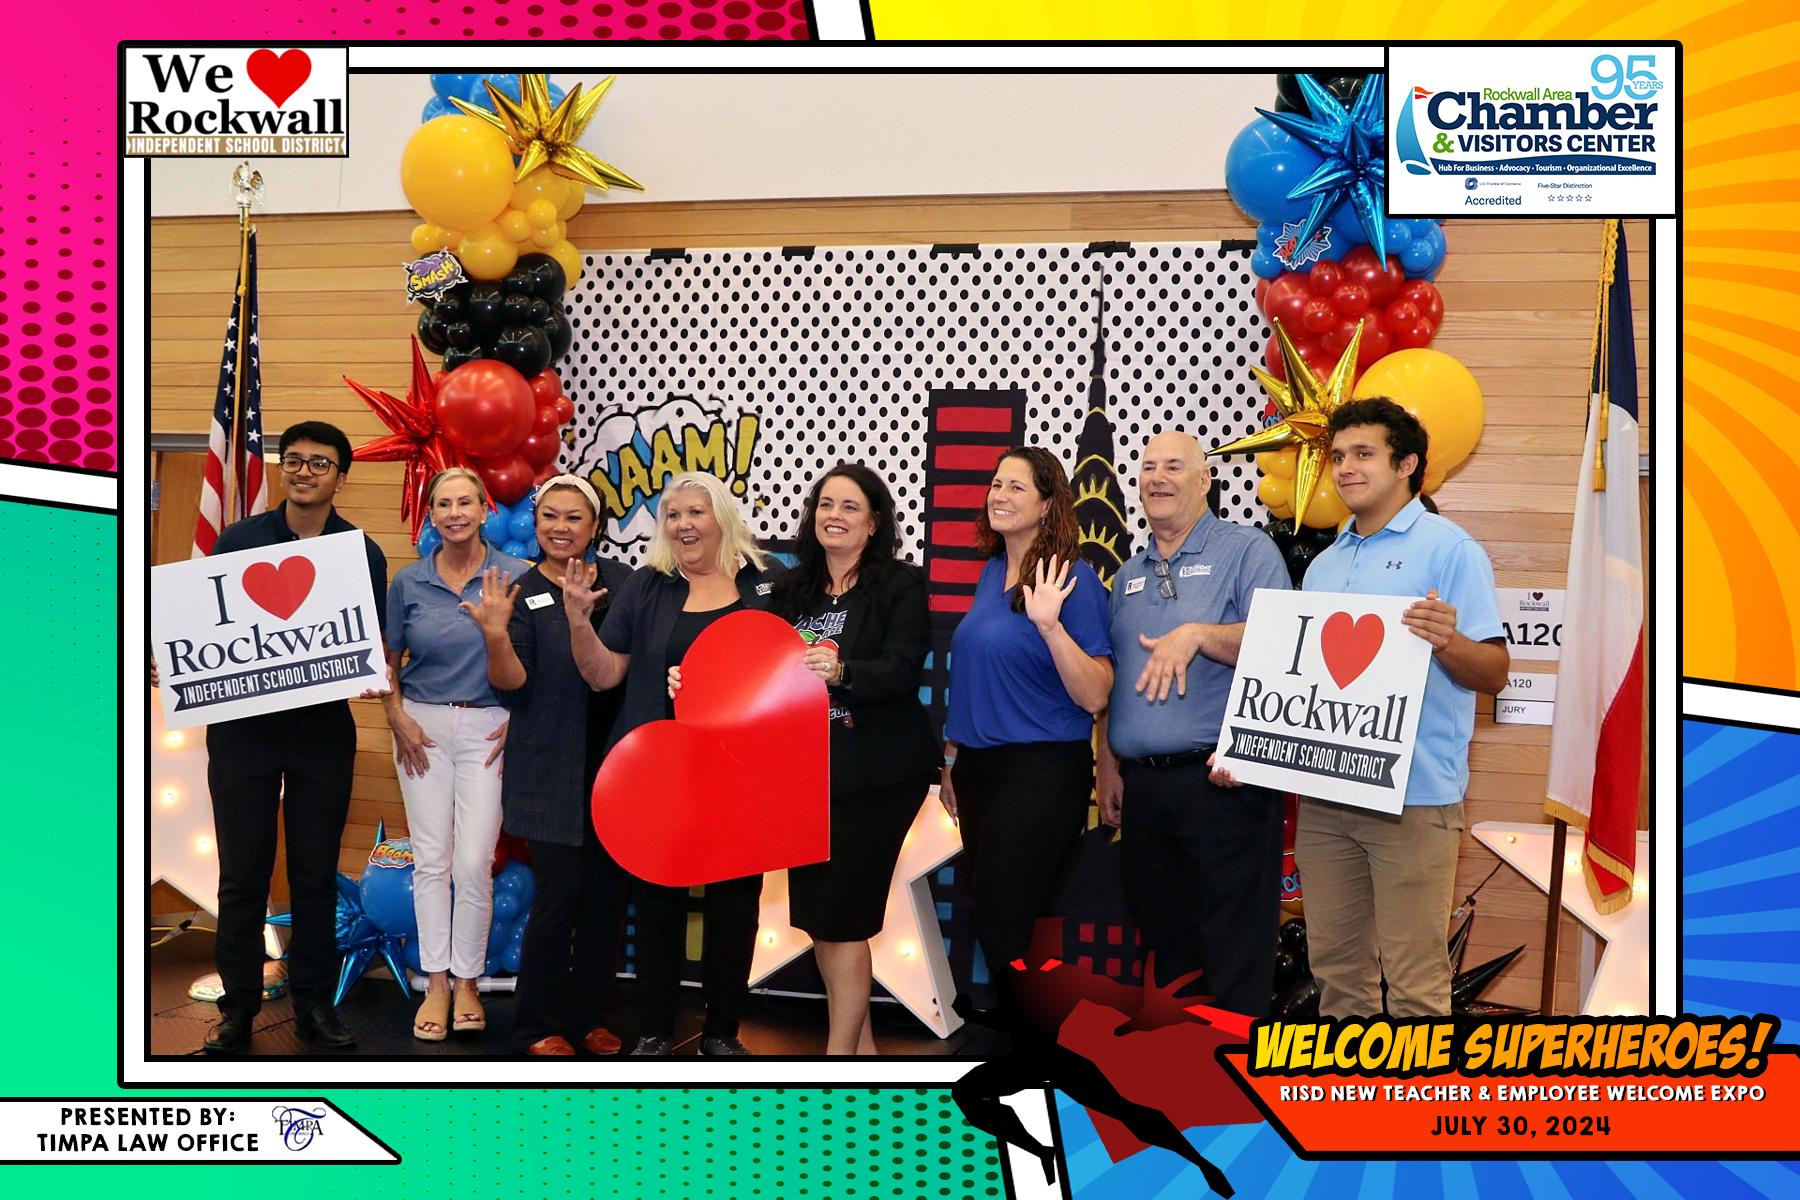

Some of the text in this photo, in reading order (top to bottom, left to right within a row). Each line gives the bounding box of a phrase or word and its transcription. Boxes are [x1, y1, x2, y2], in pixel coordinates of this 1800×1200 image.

[409, 259, 455, 291] SMASH
[207, 574, 235, 627] I
[164, 605, 371, 677] Rockwall
[1285, 615, 1314, 676] I
[182, 655, 361, 705] INDEPENDENT SCHOOL DISTRICT
[1505, 678, 1532, 689] A120
[1234, 677, 1408, 744] Rockwall
[1501, 706, 1526, 714] JURY
[1234, 732, 1387, 780] INDEPENDENT SCHOOL DISTRICT
